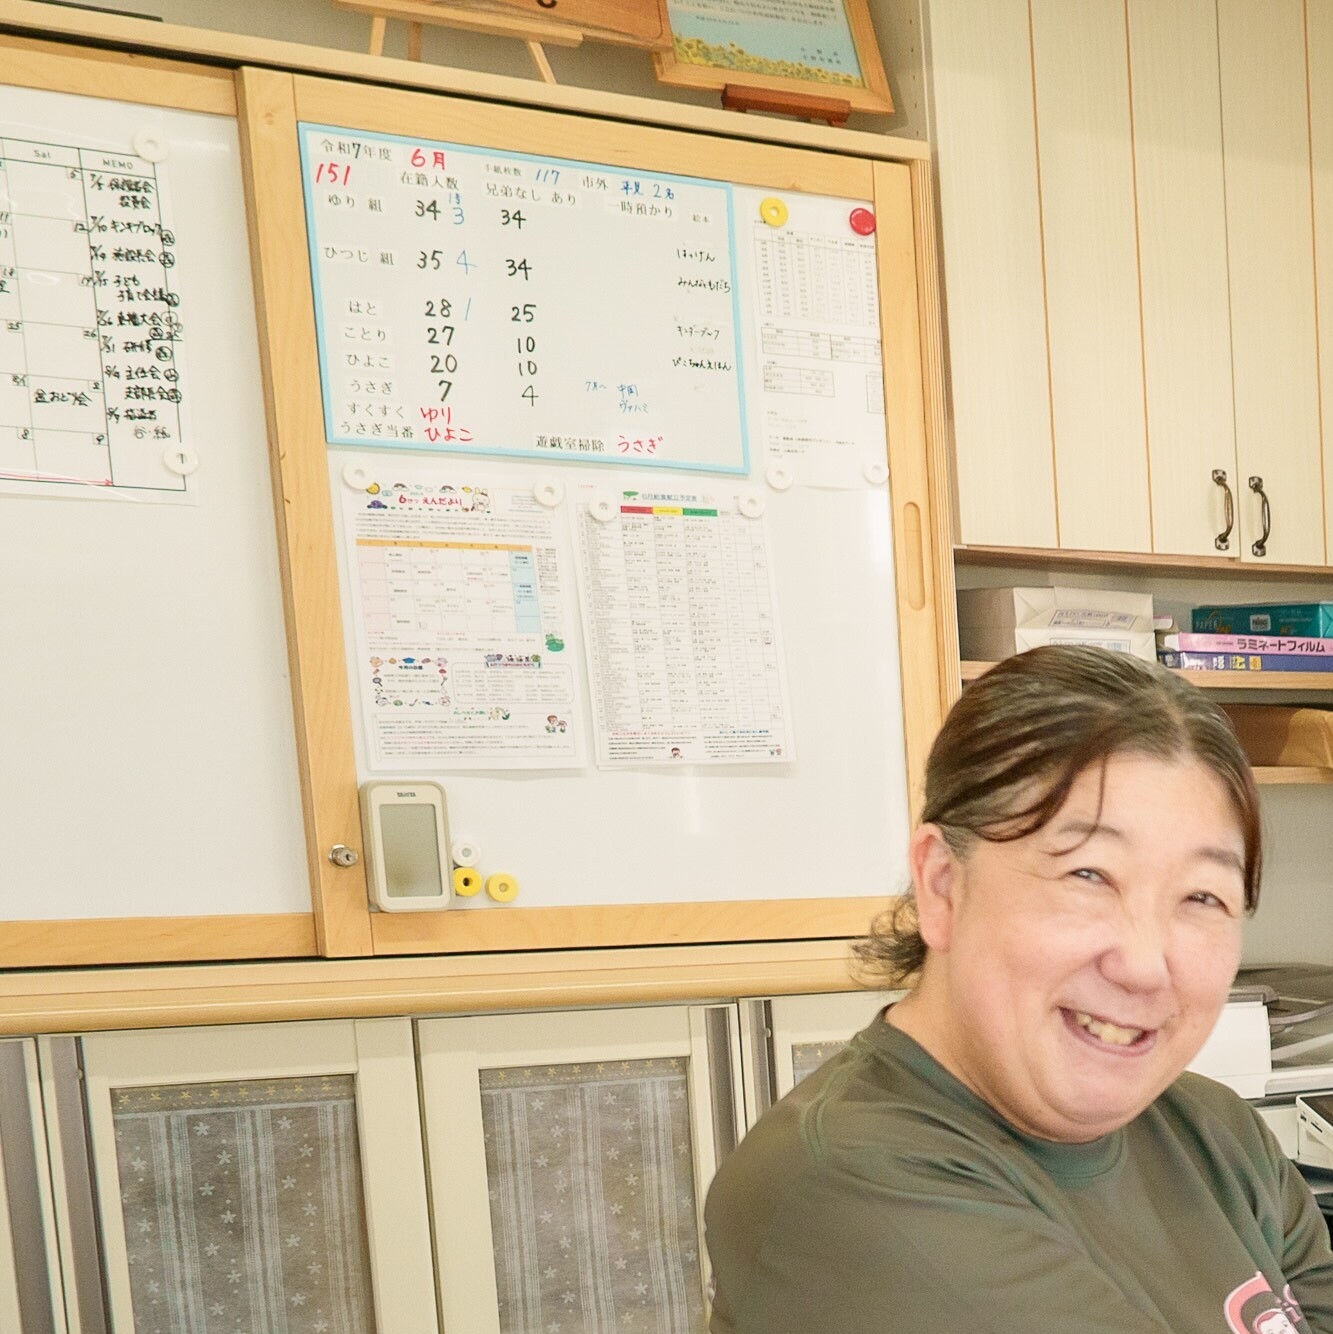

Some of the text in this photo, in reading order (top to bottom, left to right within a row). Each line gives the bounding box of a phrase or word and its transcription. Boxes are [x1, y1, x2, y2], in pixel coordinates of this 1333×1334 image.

[320, 139, 393, 161] 令和7年度
[411, 148, 446, 170] 6月
[102, 158, 134, 170] MEMO
[315, 163, 351, 186] 151
[401, 171, 460, 191] 在籍人数
[535, 168, 560, 185] 117
[582, 175, 609, 191] 市外
[328, 194, 383, 213] ゆり 組
[485, 183, 577, 206] 兄弟なし あり
[415, 199, 442, 221] 34
[452, 206, 465, 225] 3
[500, 209, 527, 229] 34
[607, 201, 673, 219] 一時預かり
[324, 246, 395, 266] ひつじ 組
[416, 250, 443, 270] 35
[456, 249, 478, 275] 4
[505, 258, 533, 281] 34
[349, 300, 378, 317] はと
[424, 298, 452, 318] 28
[511, 303, 537, 323] 25
[344, 327, 386, 342] ことり
[427, 325, 455, 346] 27
[517, 336, 536, 354] 10
[346, 353, 390, 368] ひよこ
[430, 354, 458, 374] 20
[518, 360, 538, 376] 10
[351, 380, 393, 395] うさぎ
[438, 380, 452, 402] 7
[521, 385, 539, 407] 4
[348, 403, 406, 420] すくすく
[420, 406, 452, 424] ゆり
[340, 422, 415, 439] うさぎ当番
[424, 427, 475, 442] ひよこ
[617, 435, 664, 453] うさぎ
[1237, 638, 1326, 653] ラミネートフィルム
